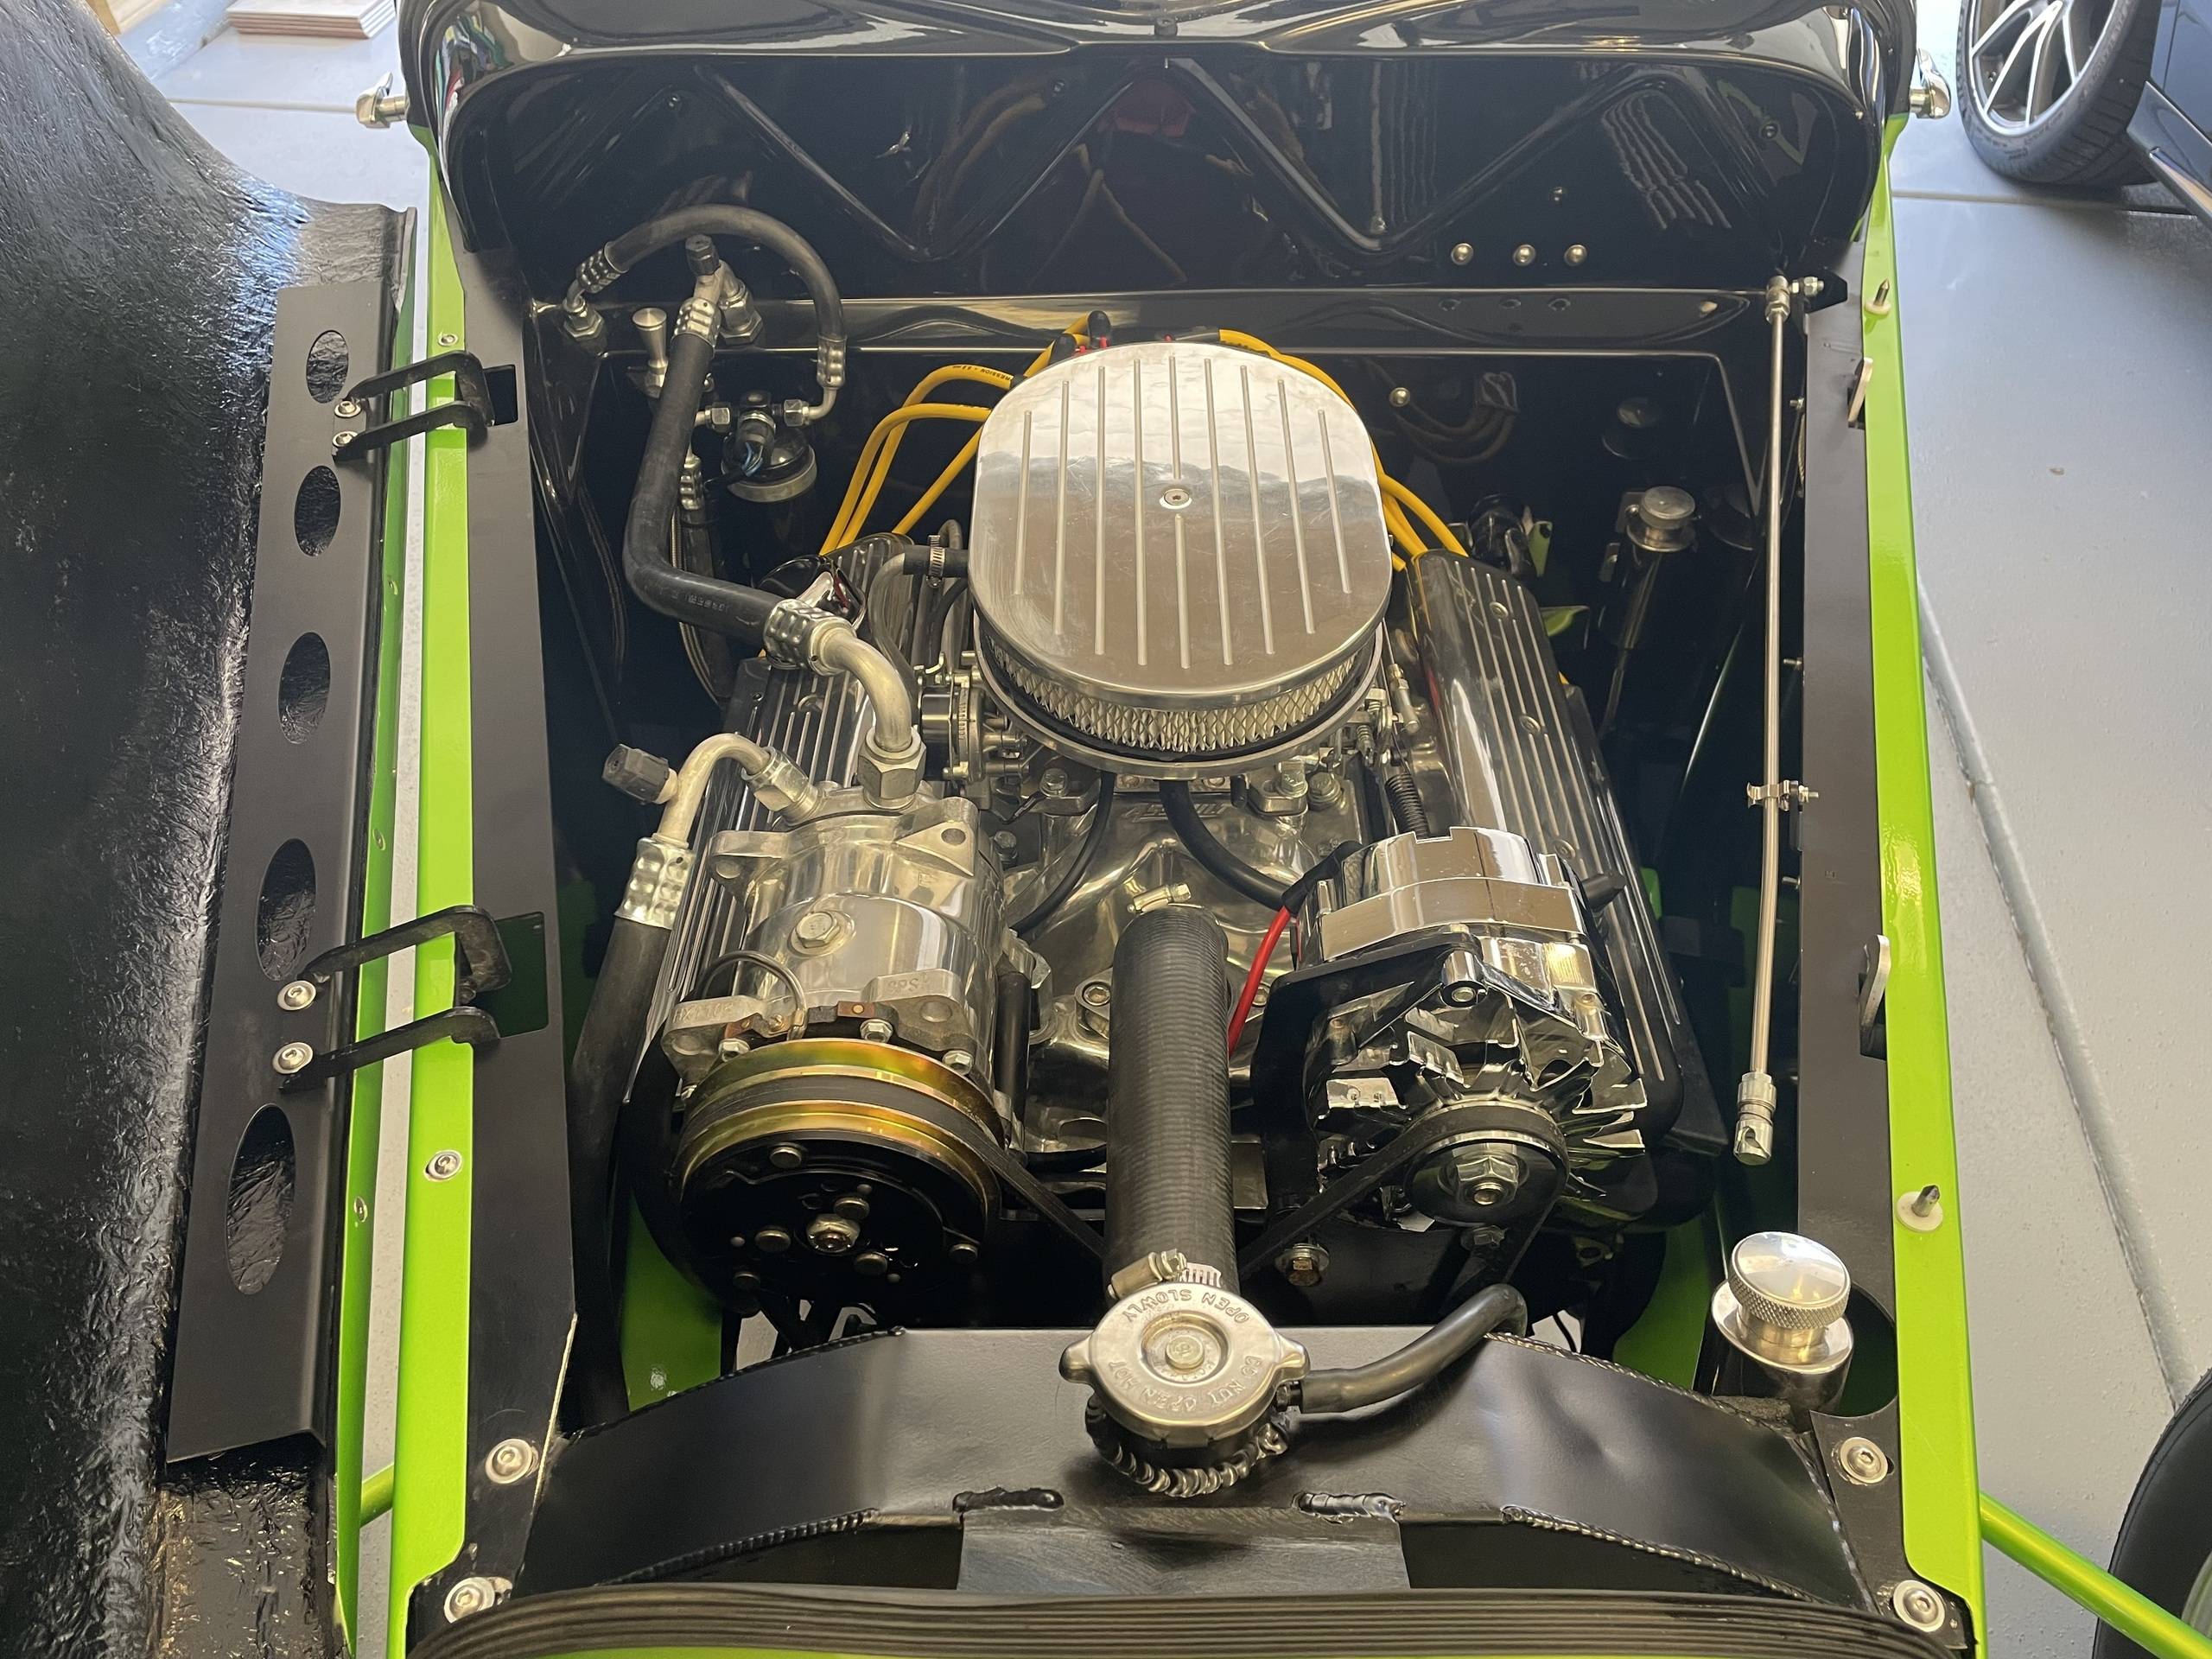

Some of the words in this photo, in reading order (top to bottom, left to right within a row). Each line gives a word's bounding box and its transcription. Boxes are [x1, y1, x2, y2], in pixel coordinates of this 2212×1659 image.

[1122, 1289, 1192, 1322] SLOWLY
[1202, 1292, 1249, 1324] OPEN
[1107, 1360, 1141, 1390] HOT
[1241, 1355, 1263, 1377] DO
[1140, 1387, 1198, 1413] OPEN
[1207, 1377, 1243, 1408] NOT
